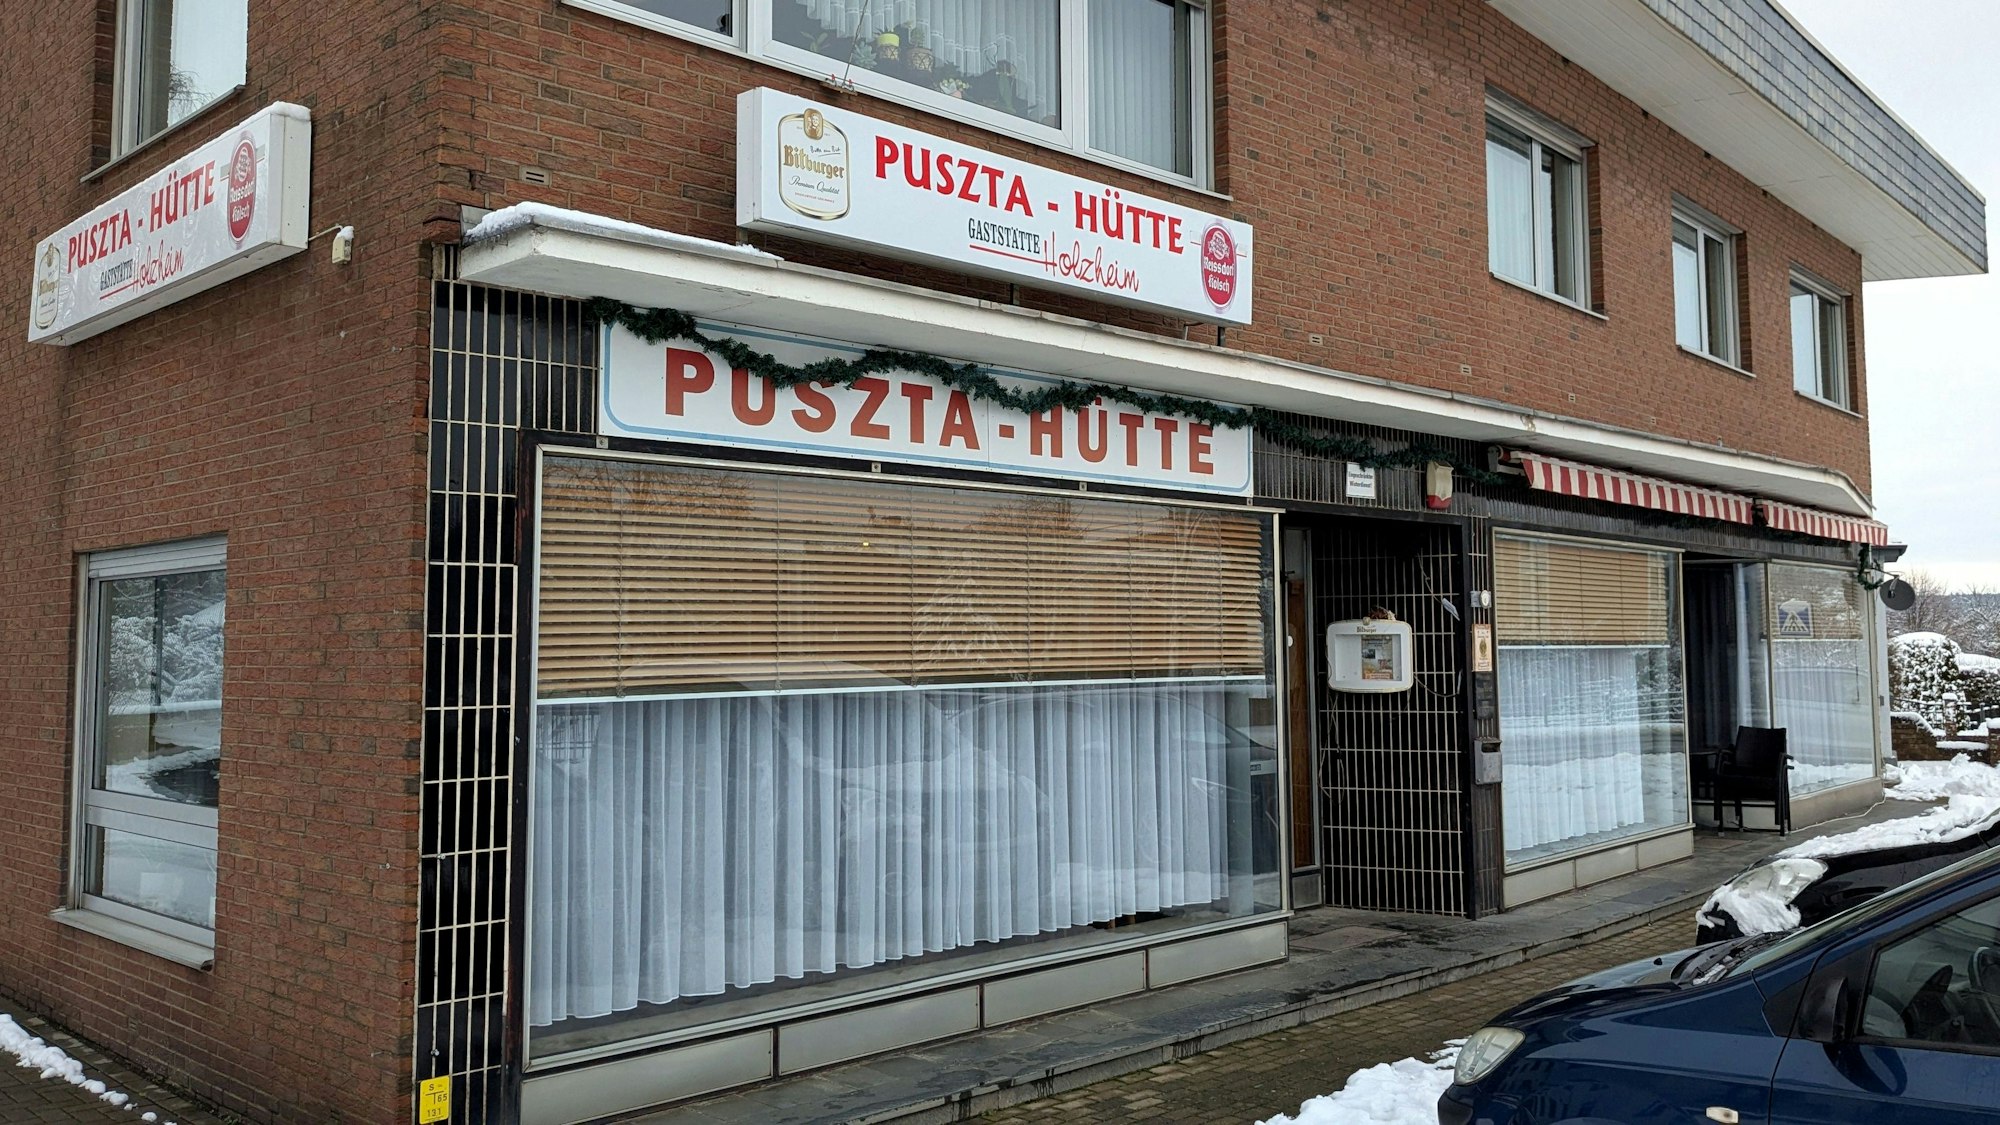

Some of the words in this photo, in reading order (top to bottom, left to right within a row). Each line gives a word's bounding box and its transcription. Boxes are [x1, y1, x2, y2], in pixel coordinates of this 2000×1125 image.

[783, 144, 845, 179] Bitburger
[788, 175, 815, 190] Premium
[875, 135, 1034, 218] PUSZTA
[1074, 188, 1184, 254] HÜTTE
[67, 208, 132, 274] PUSZTA
[150, 160, 215, 233] HÜTTE
[968, 217, 1041, 255] GASTSTÄTTE
[100, 258, 133, 291] GASTSTÄTTE
[132, 239, 184, 294] Holzheim
[1043, 231, 1140, 293] Holzheim
[1203, 256, 1235, 277] Reissdorf
[1208, 273, 1230, 294] Kölsch
